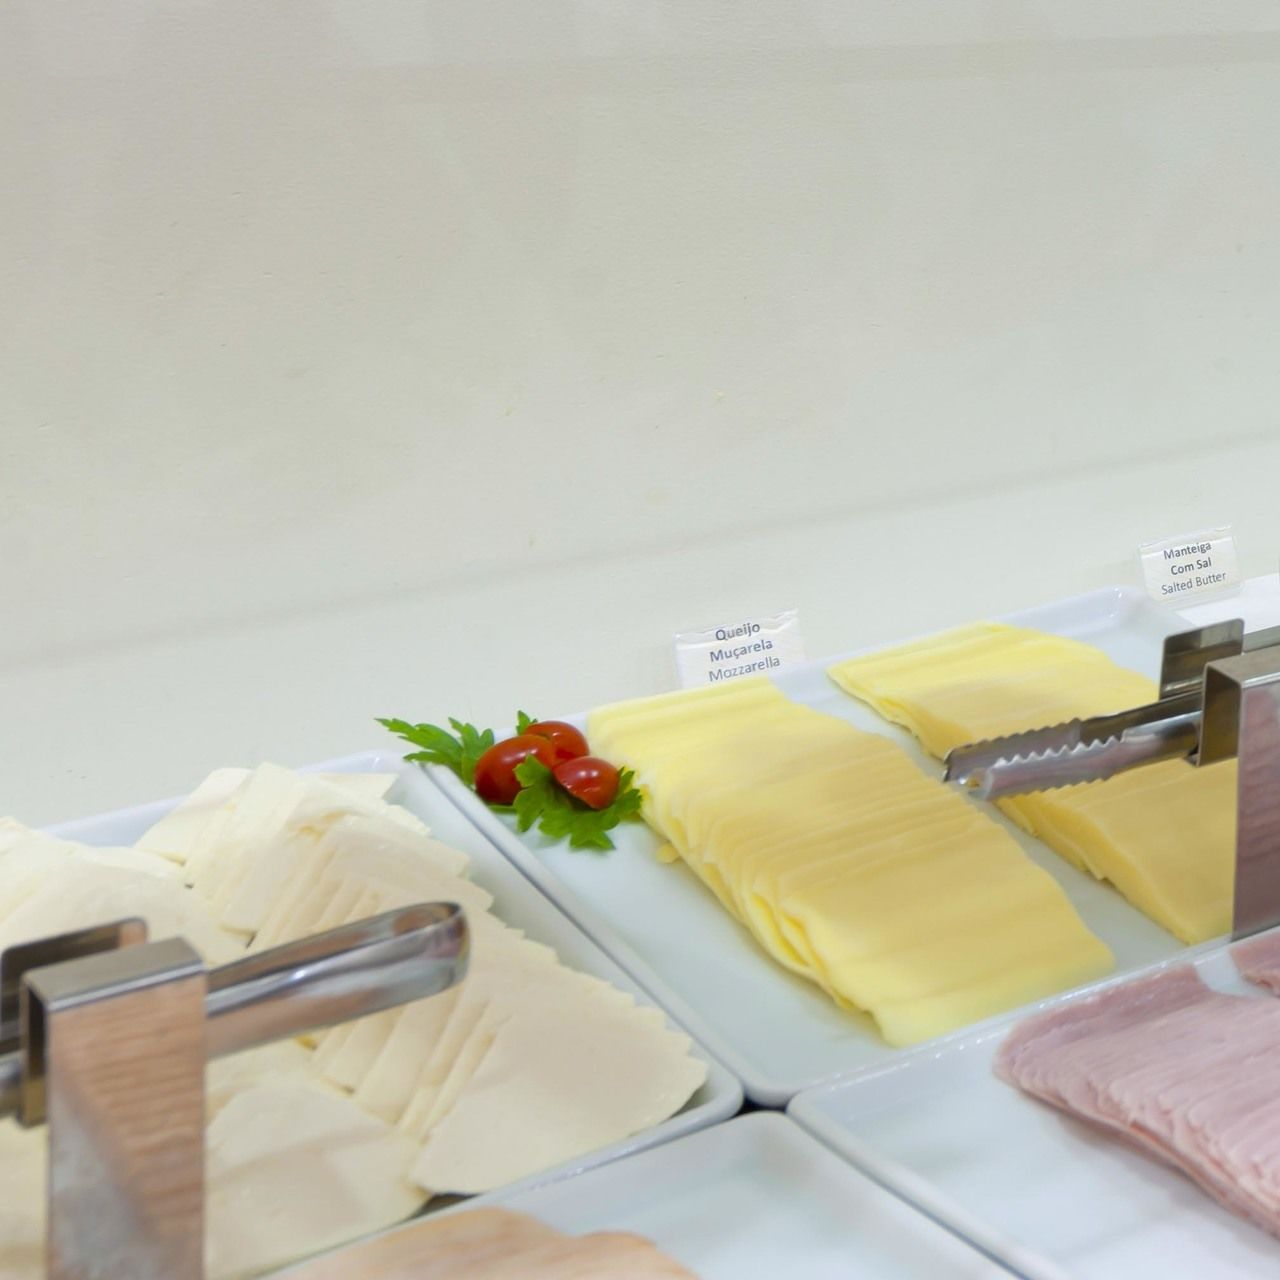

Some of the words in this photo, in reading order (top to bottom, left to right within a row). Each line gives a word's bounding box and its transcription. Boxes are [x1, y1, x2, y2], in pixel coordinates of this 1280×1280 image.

[1163, 542, 1213, 561] Manteiga
[1170, 563, 1195, 576] Com
[1196, 556, 1212, 571] Sal
[1161, 578, 1193, 596] Salted
[1195, 571, 1227, 588] Butter
[715, 622, 761, 642] Queijo
[709, 639, 774, 663] Muçarela
[708, 656, 781, 683] Mozzarella
